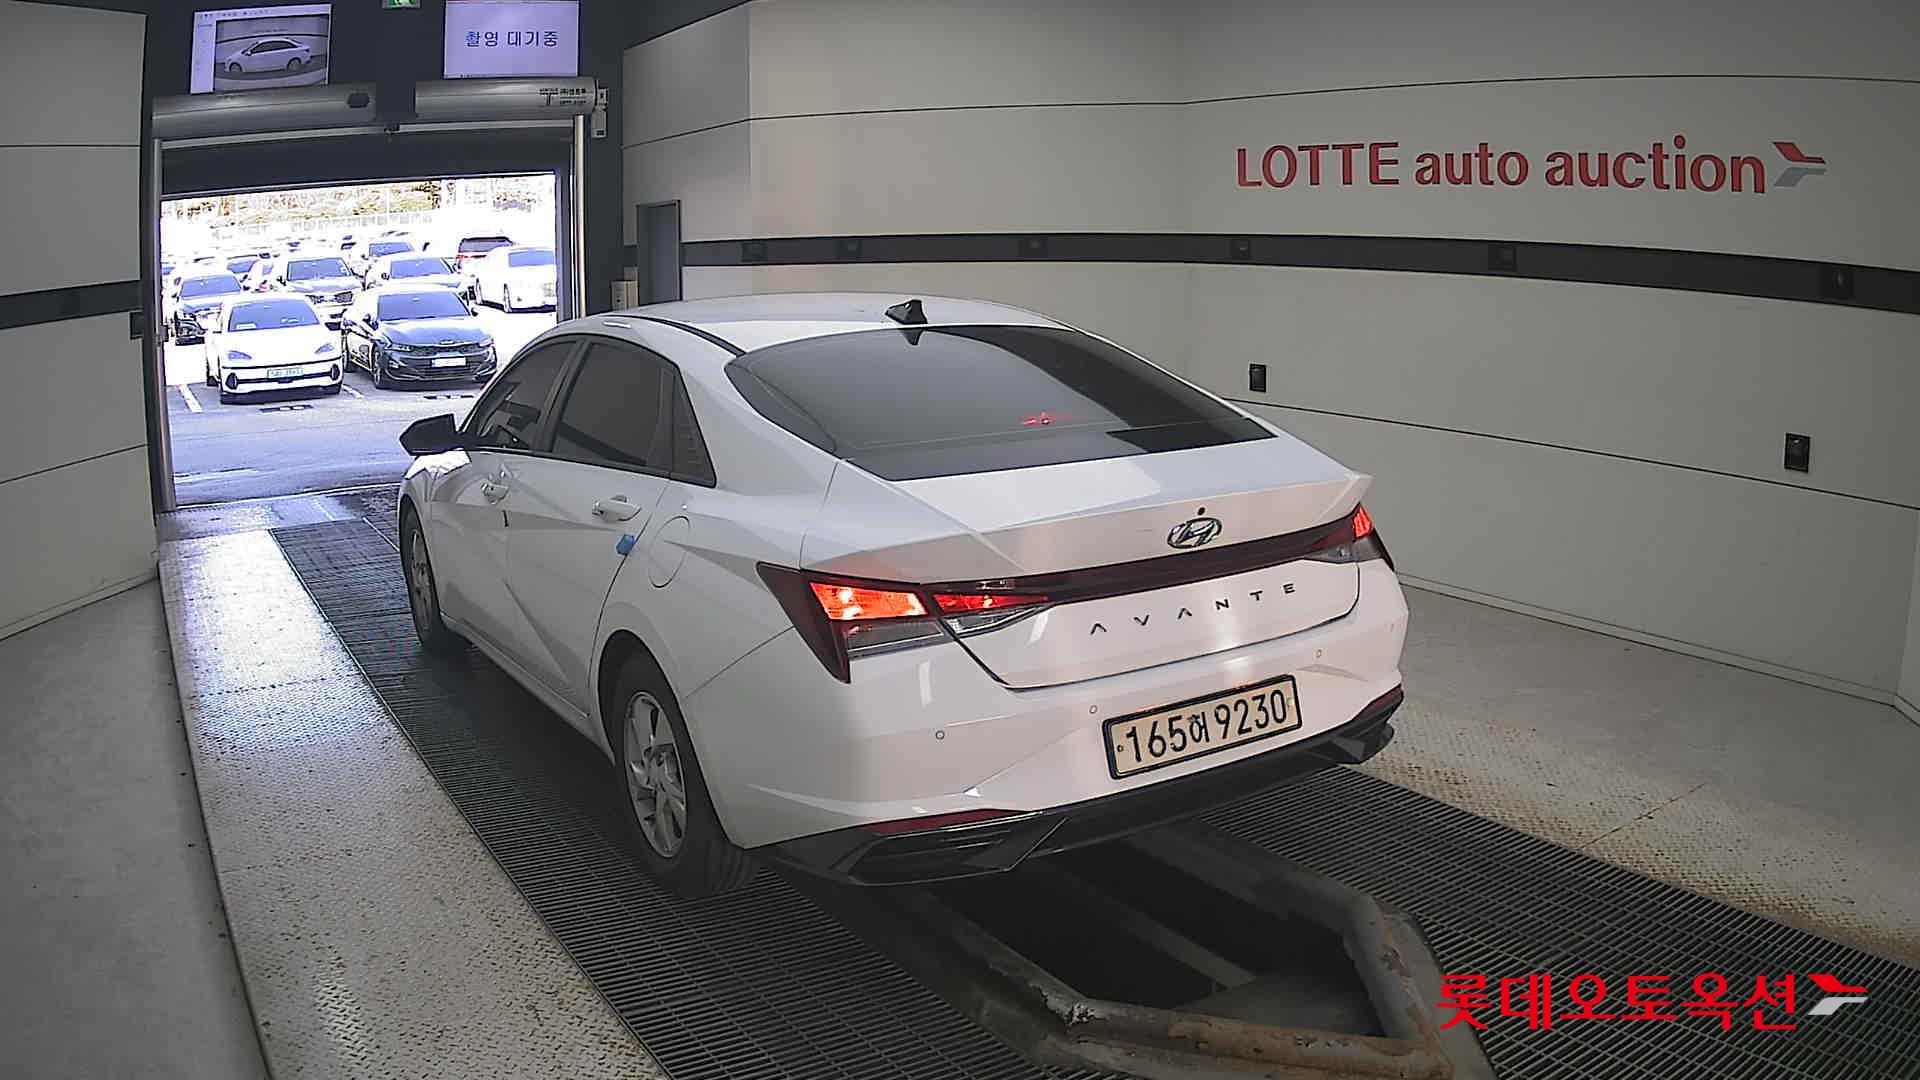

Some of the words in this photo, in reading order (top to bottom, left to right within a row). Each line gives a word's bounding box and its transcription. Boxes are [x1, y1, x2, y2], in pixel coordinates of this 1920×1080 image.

[466, 31, 498, 47] 촬영
[507, 31, 559, 47] 대기중
[1237, 142, 1399, 188] LOTTE
[1415, 142, 1529, 186] auto
[1544, 135, 1765, 194] auction
[1090, 583, 1296, 635] AVANTE
